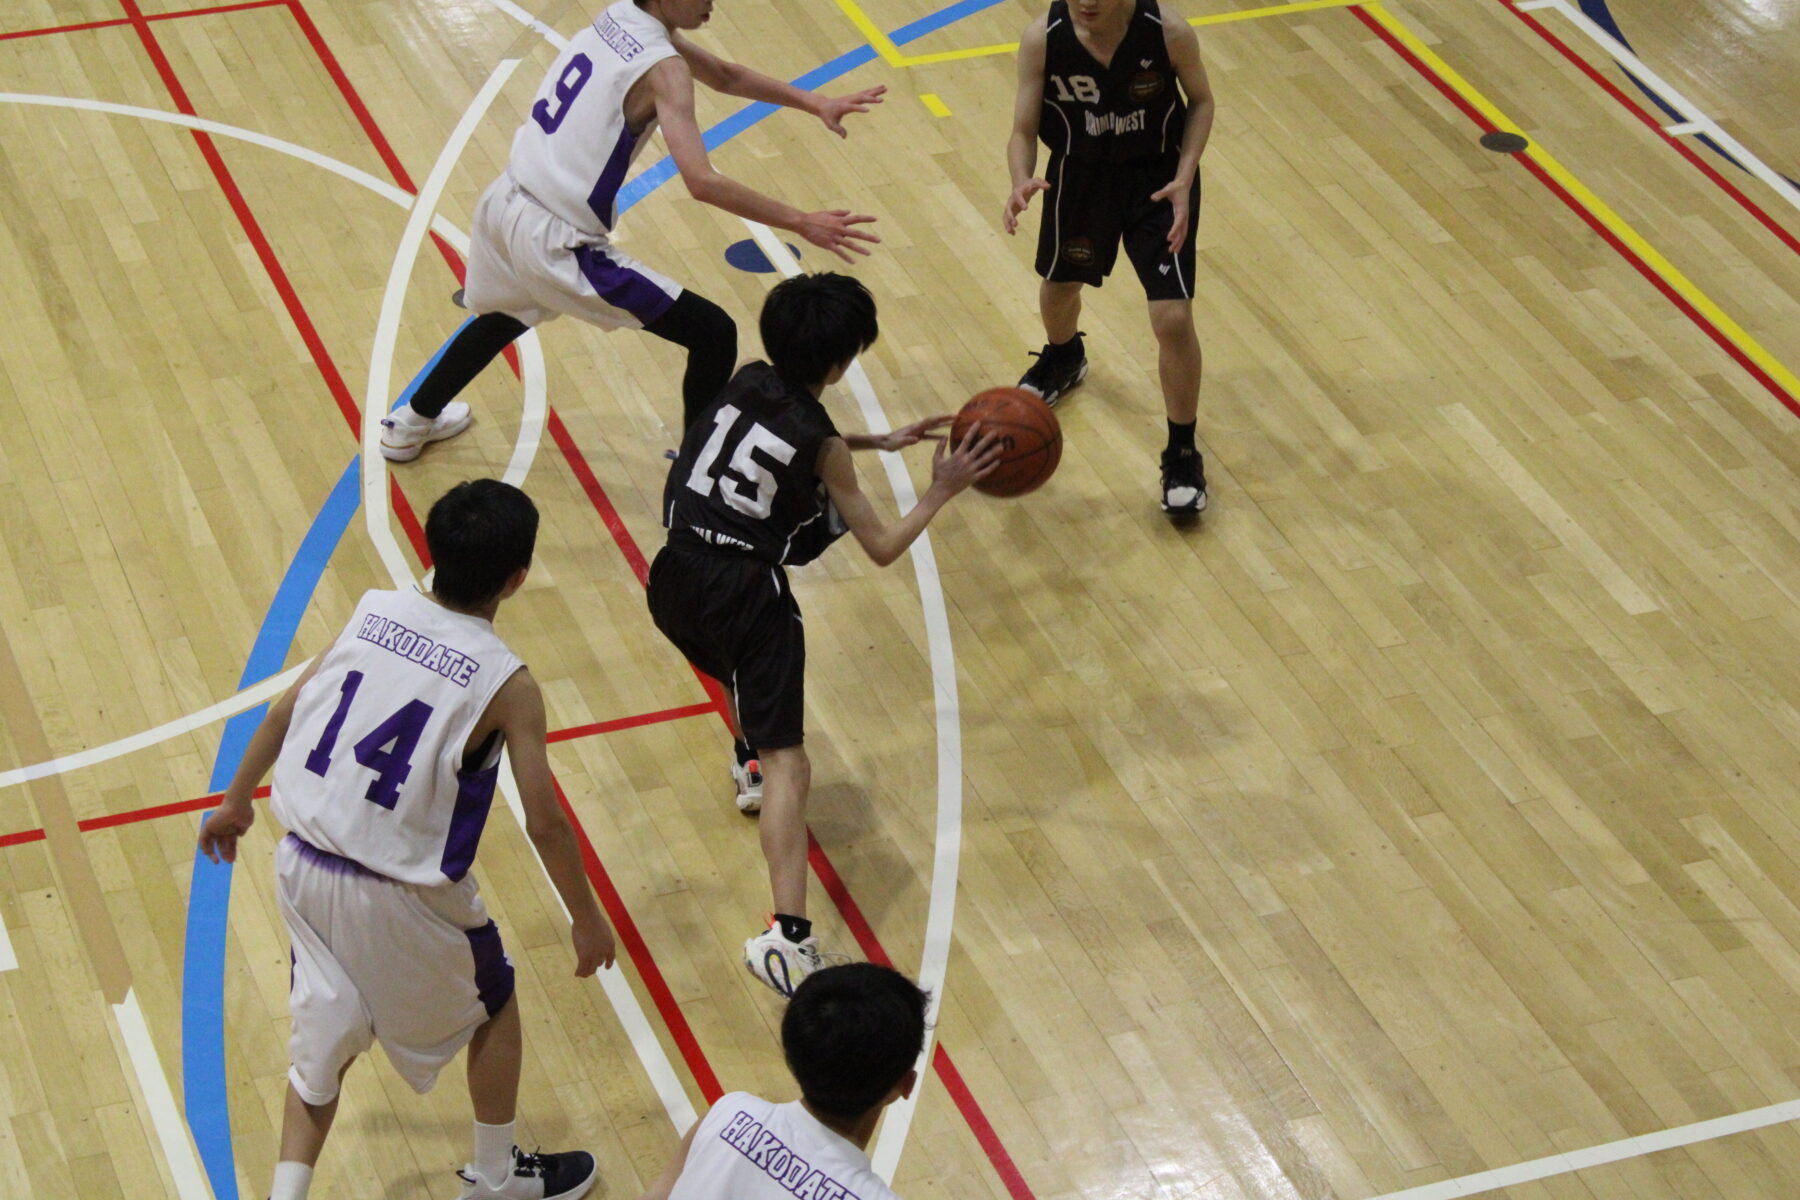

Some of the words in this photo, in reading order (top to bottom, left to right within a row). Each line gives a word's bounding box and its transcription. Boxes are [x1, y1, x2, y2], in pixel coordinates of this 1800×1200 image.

[532, 53, 593, 135] 9
[1051, 75, 1100, 104] 18
[1115, 109, 1146, 136] WEST
[686, 403, 797, 520] 15
[357, 613, 480, 688] HAKODATE
[304, 669, 434, 811] 14
[720, 1110, 861, 1200] HAKODAT
